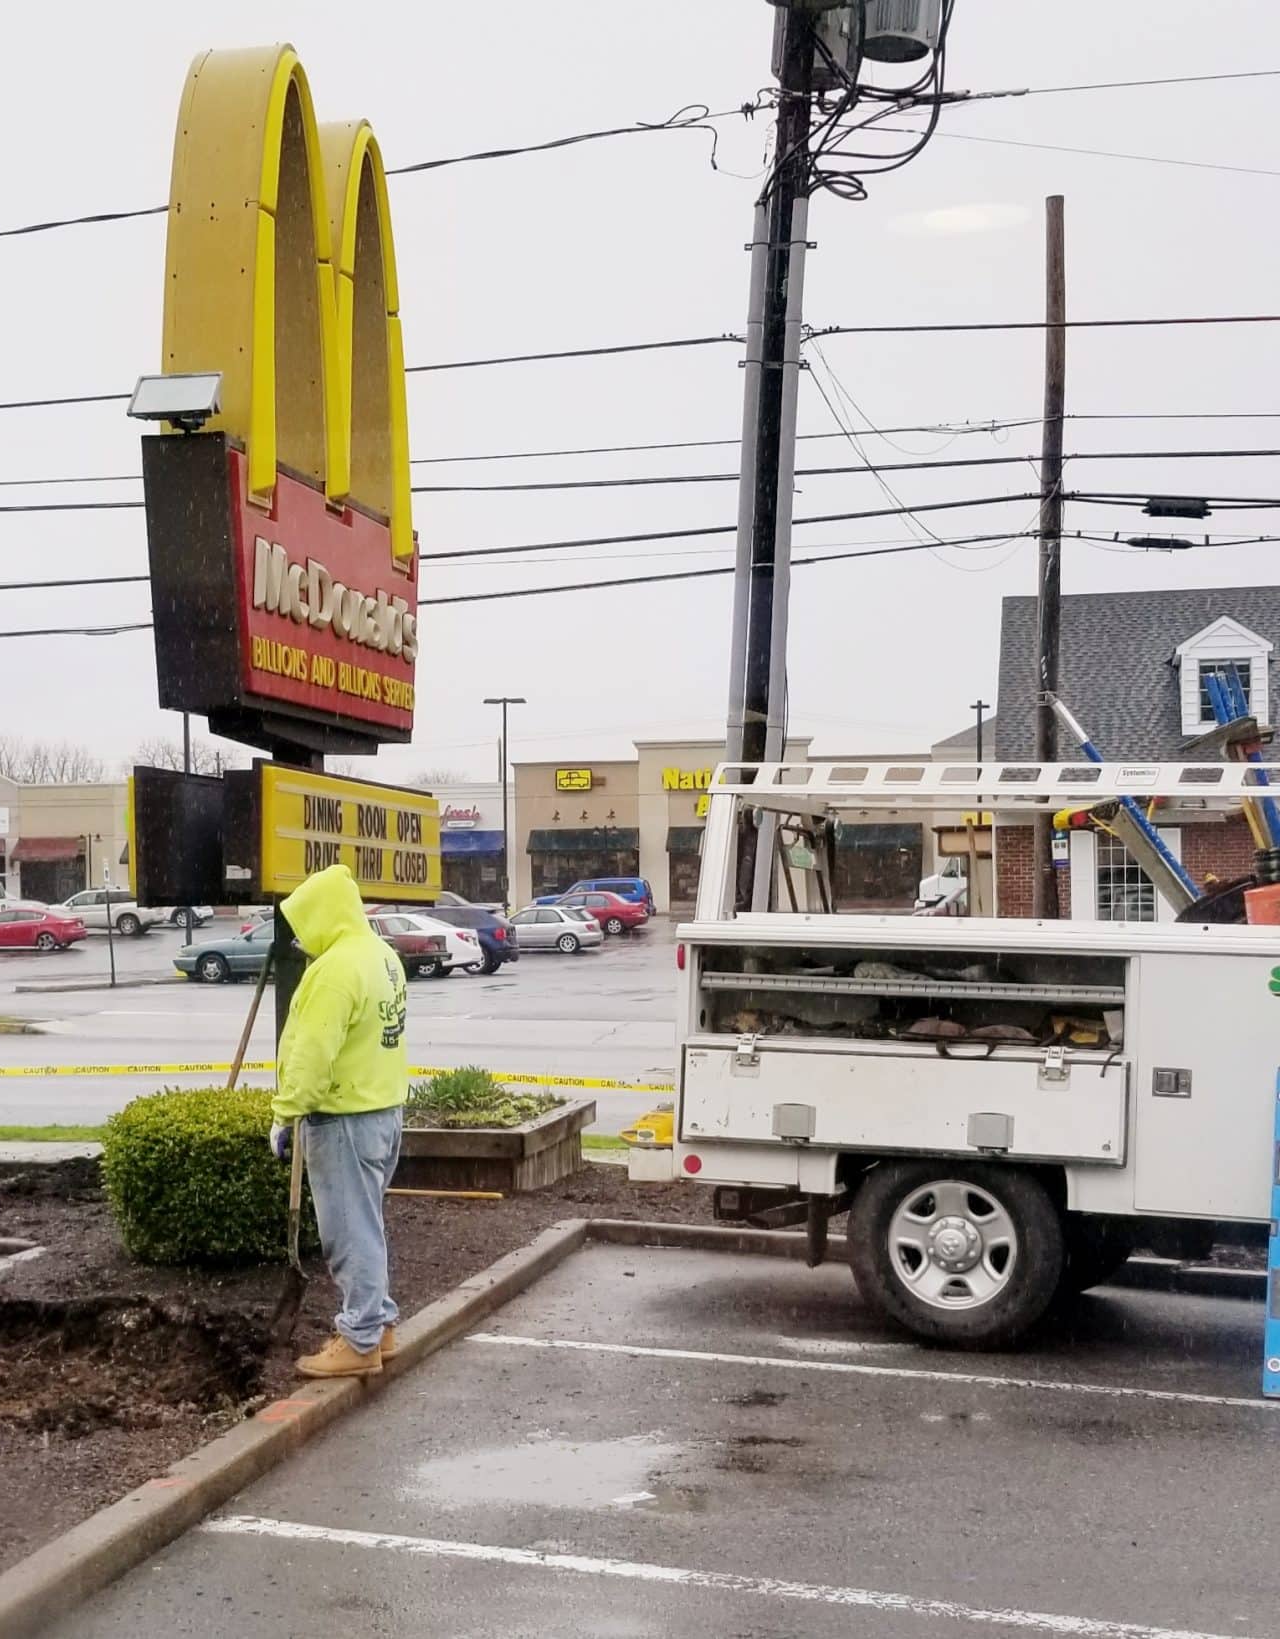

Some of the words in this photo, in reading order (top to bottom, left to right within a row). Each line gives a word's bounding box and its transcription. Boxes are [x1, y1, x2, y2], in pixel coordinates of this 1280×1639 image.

[252, 636, 308, 681] BILLIONS
[311, 655, 335, 688] AND
[338, 662, 381, 701] BILLIONS
[304, 794, 342, 834] DINING
[357, 804, 387, 840] ROOM
[397, 810, 422, 844] OPEN
[305, 840, 340, 875] DRIVE
[355, 846, 383, 880] THRU
[393, 851, 427, 883] CLOSED
[75, 1065, 110, 1073] CAUTION
[127, 1065, 161, 1073] CAUTION
[179, 1064, 213, 1072] CAUTION
[507, 1074, 538, 1083] CAUTION
[554, 1077, 585, 1086] CAUTION
